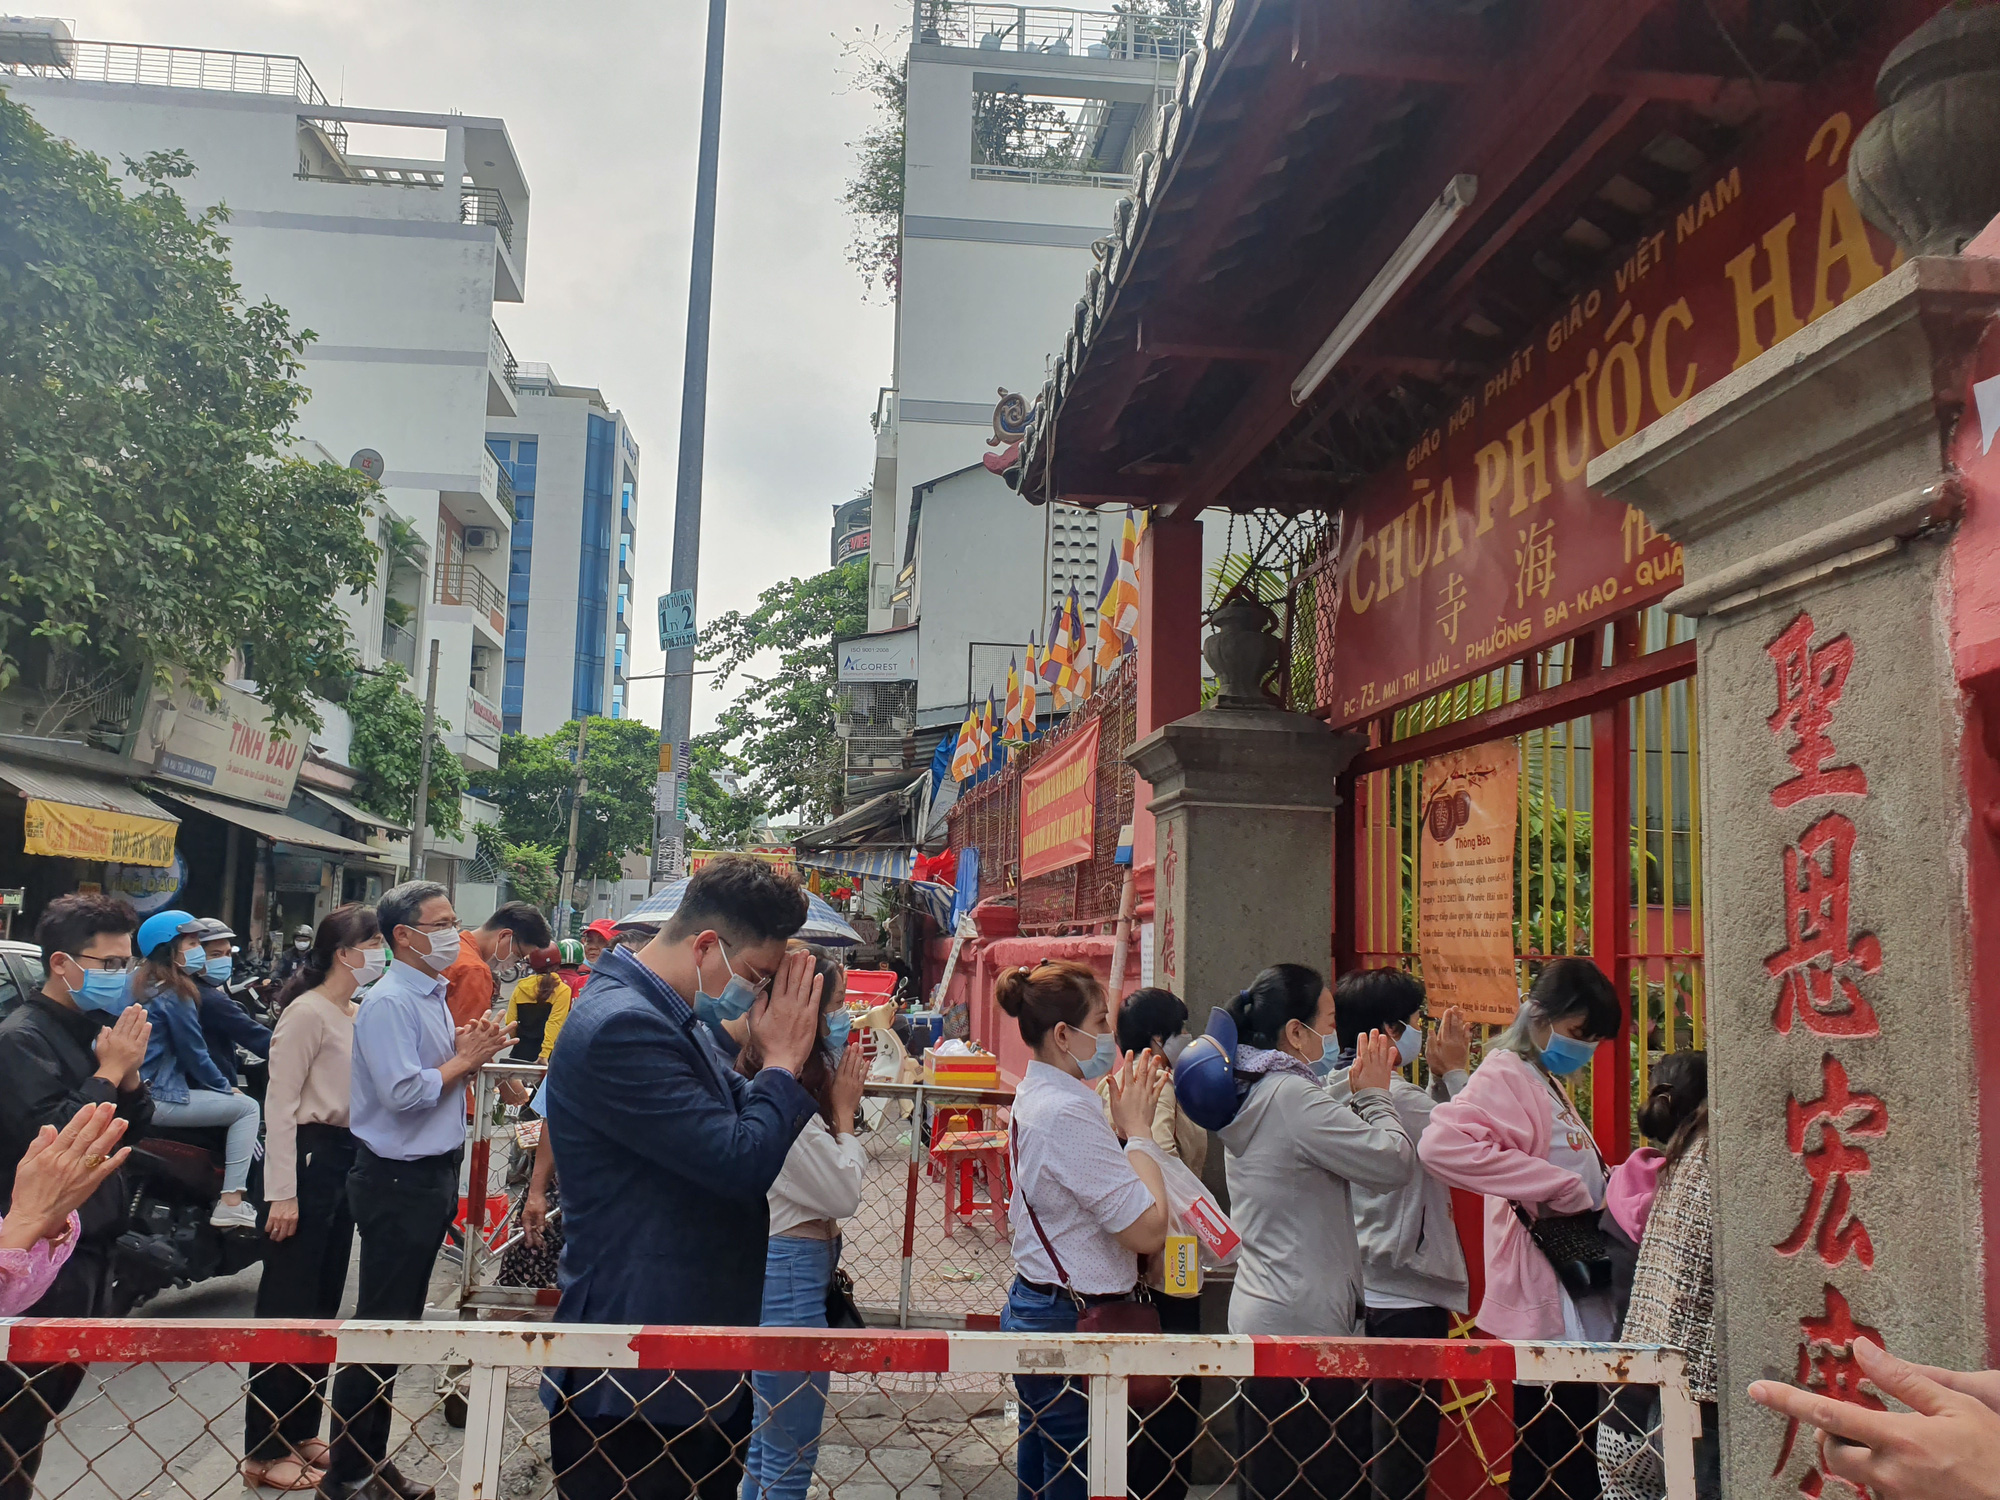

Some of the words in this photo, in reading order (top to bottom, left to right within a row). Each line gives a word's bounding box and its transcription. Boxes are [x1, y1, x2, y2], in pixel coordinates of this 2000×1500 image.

[1348, 476, 1464, 616] CHÙA
[1474, 296, 1697, 538] PHƯỚC
[1723, 111, 1905, 373] HẢ
[1406, 428, 1441, 472] GIÁO
[1448, 395, 1476, 437] HỘI
[1547, 289, 1601, 352] GIÁO
[1615, 229, 1666, 293] VIỆT
[1676, 166, 1741, 245] NAM
[660, 610, 669, 634] 1
[681, 605, 694, 630] 2
[843, 655, 898, 671] ALCOREST
[1382, 678, 1400, 702] MAI
[1403, 668, 1421, 691] THỊ
[1466, 615, 1532, 664] PHƯỜNG
[1635, 541, 1685, 586] QUẬ
[1175, 1243, 1187, 1288] Custas
